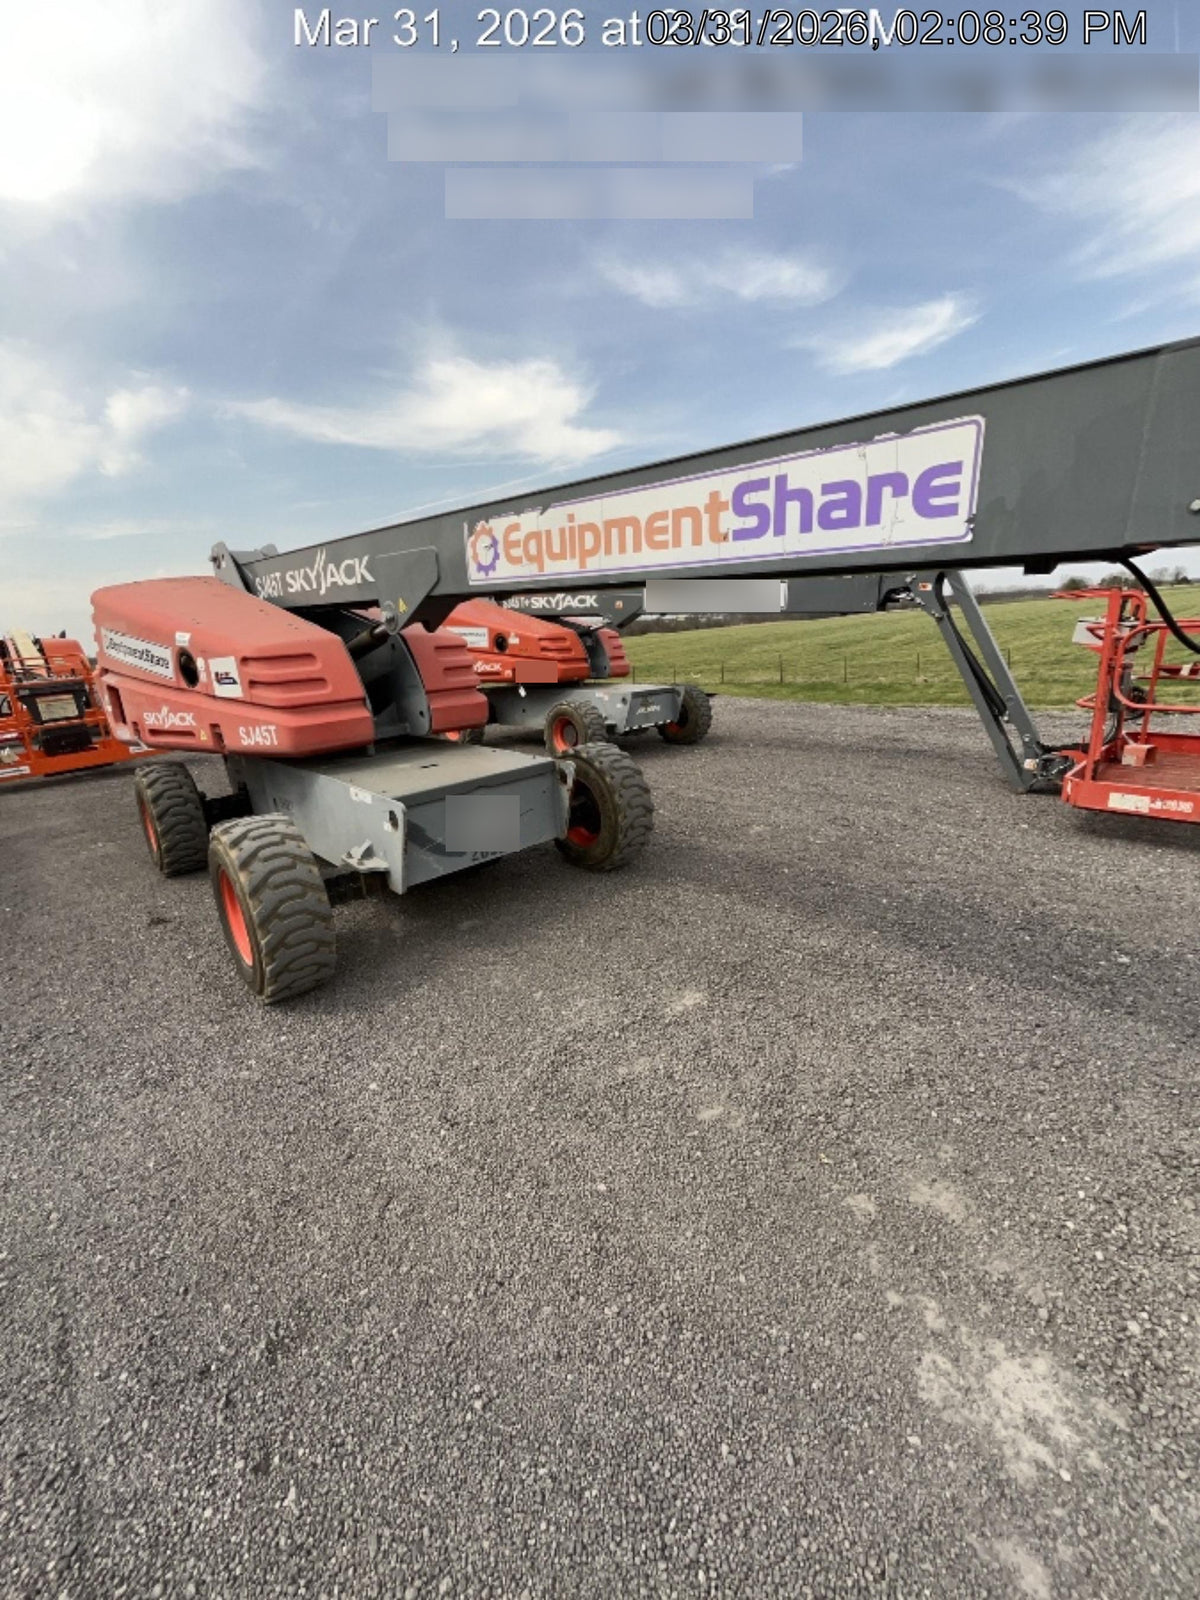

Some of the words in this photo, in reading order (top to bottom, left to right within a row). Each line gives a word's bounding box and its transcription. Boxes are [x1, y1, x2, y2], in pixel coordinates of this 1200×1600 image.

[502, 460, 965, 573] EquipmentShare
[285, 548, 376, 595] SKYJACK
[530, 593, 599, 611] SKYJACK
[143, 705, 197, 728] SKYJACK
[239, 725, 279, 746] SJ45T
